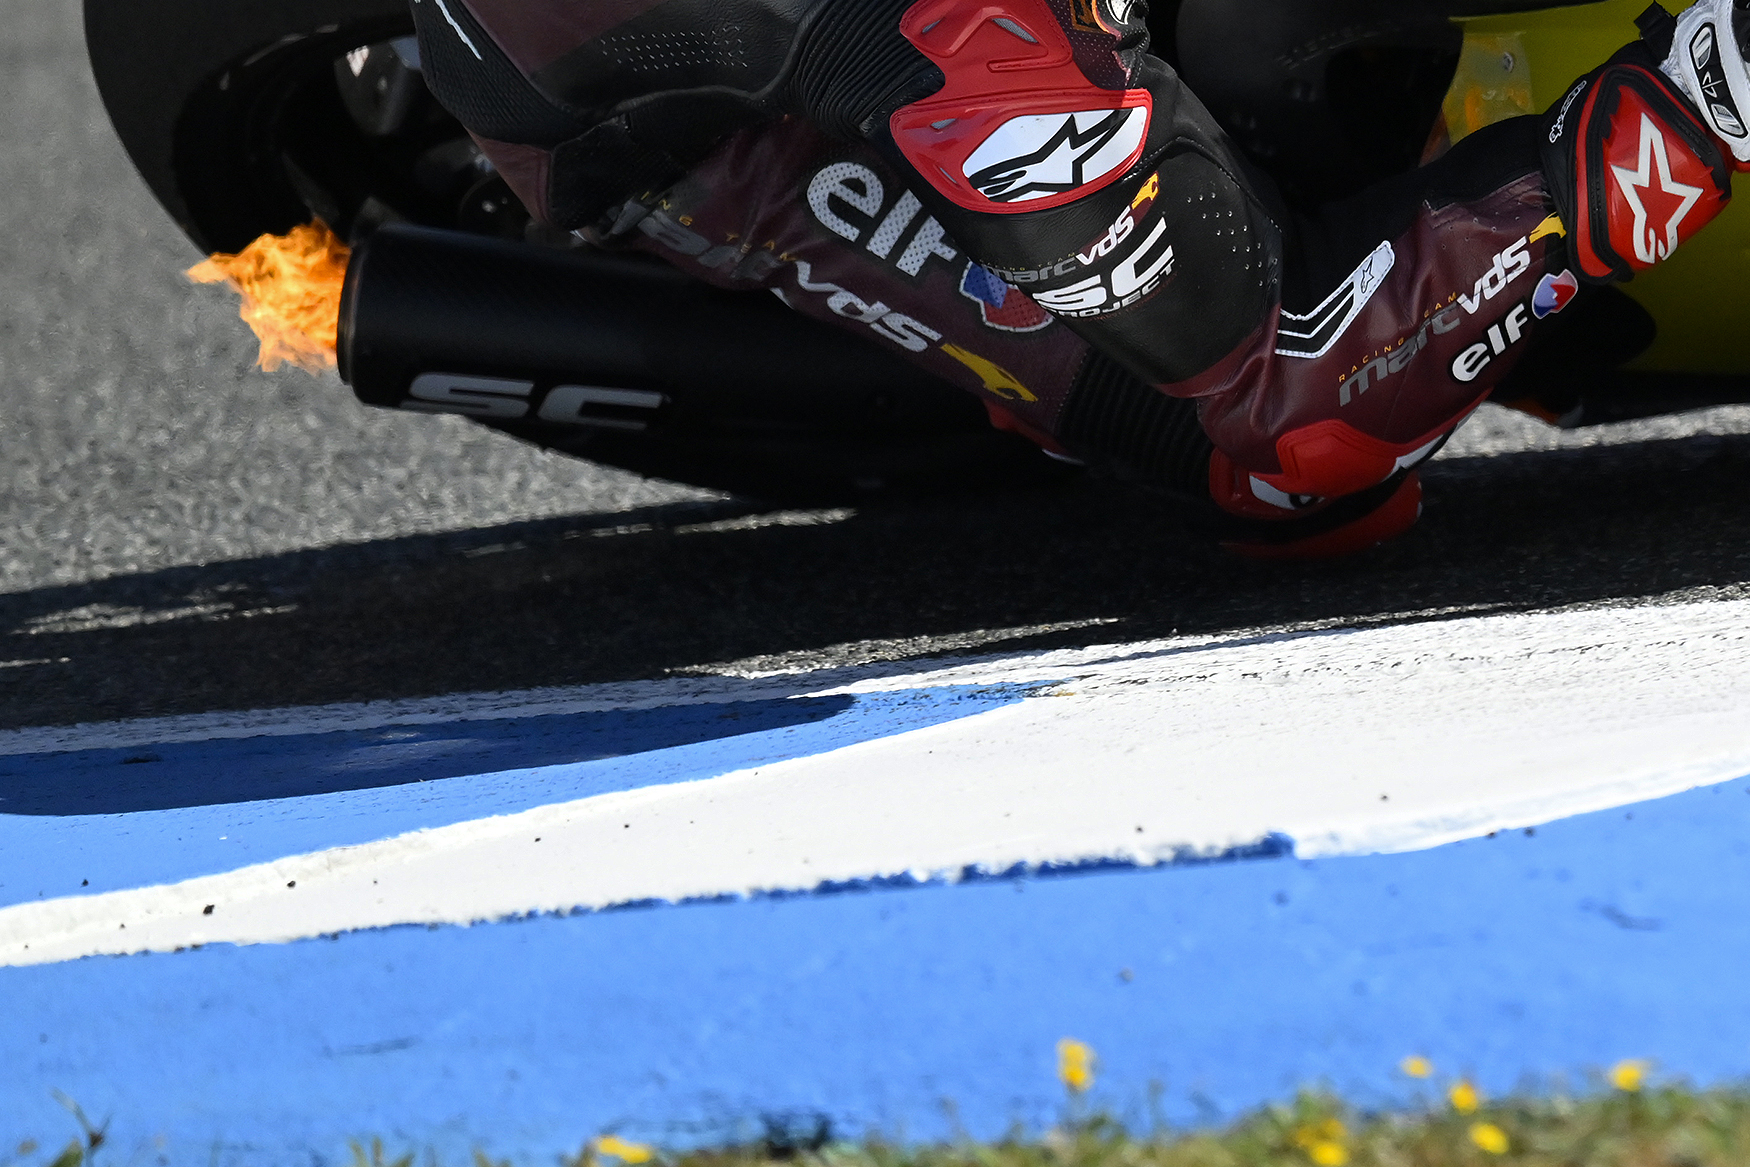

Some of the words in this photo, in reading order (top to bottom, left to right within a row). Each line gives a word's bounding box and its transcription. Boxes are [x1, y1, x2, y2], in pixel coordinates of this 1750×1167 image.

[1032, 216, 1167, 312] SC
[1338, 337, 1405, 383] RACING
[1452, 303, 1529, 382] elf
[408, 372, 664, 430] SC
